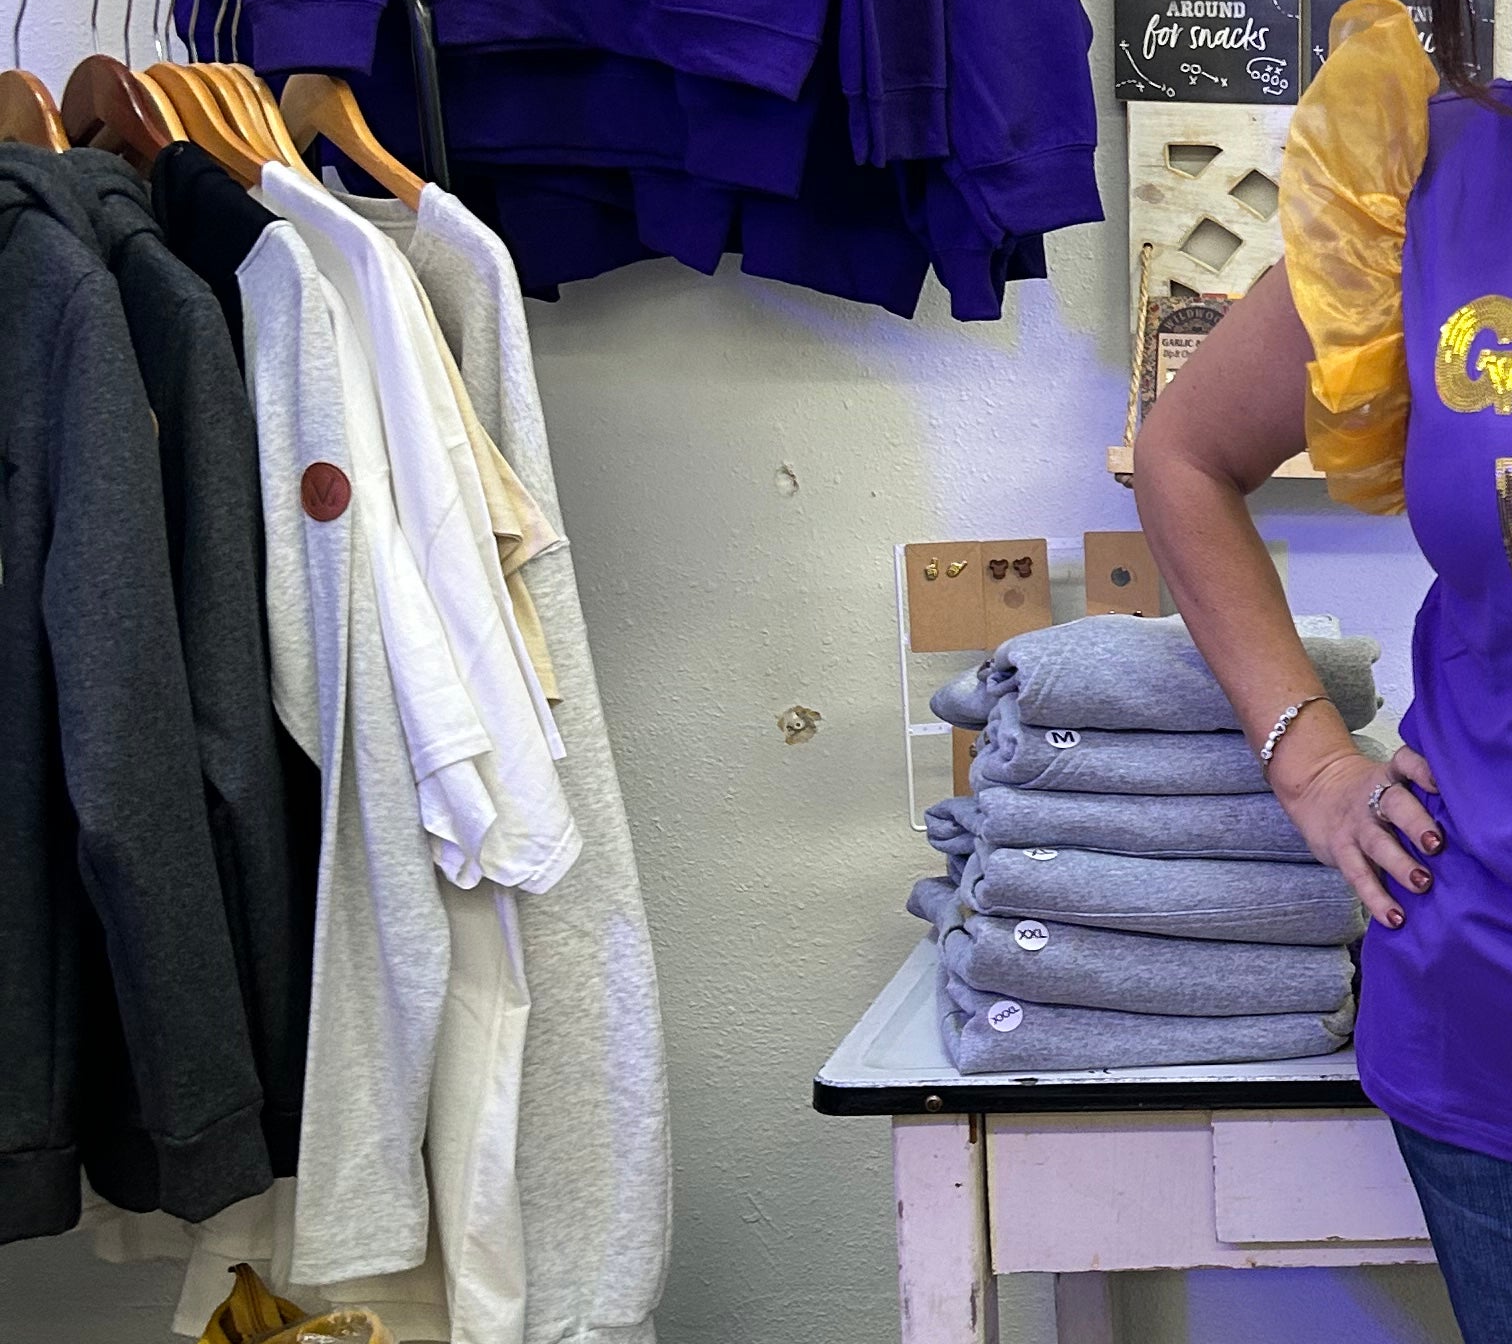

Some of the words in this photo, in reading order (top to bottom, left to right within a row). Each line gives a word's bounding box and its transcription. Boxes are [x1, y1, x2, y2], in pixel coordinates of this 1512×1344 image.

[1166, 0, 1246, 18] AROUND
[1143, 13, 1184, 60] for
[1189, 17, 1270, 51] snacks
[1162, 338, 1194, 348] GARLIC
[1051, 731, 1075, 744] M
